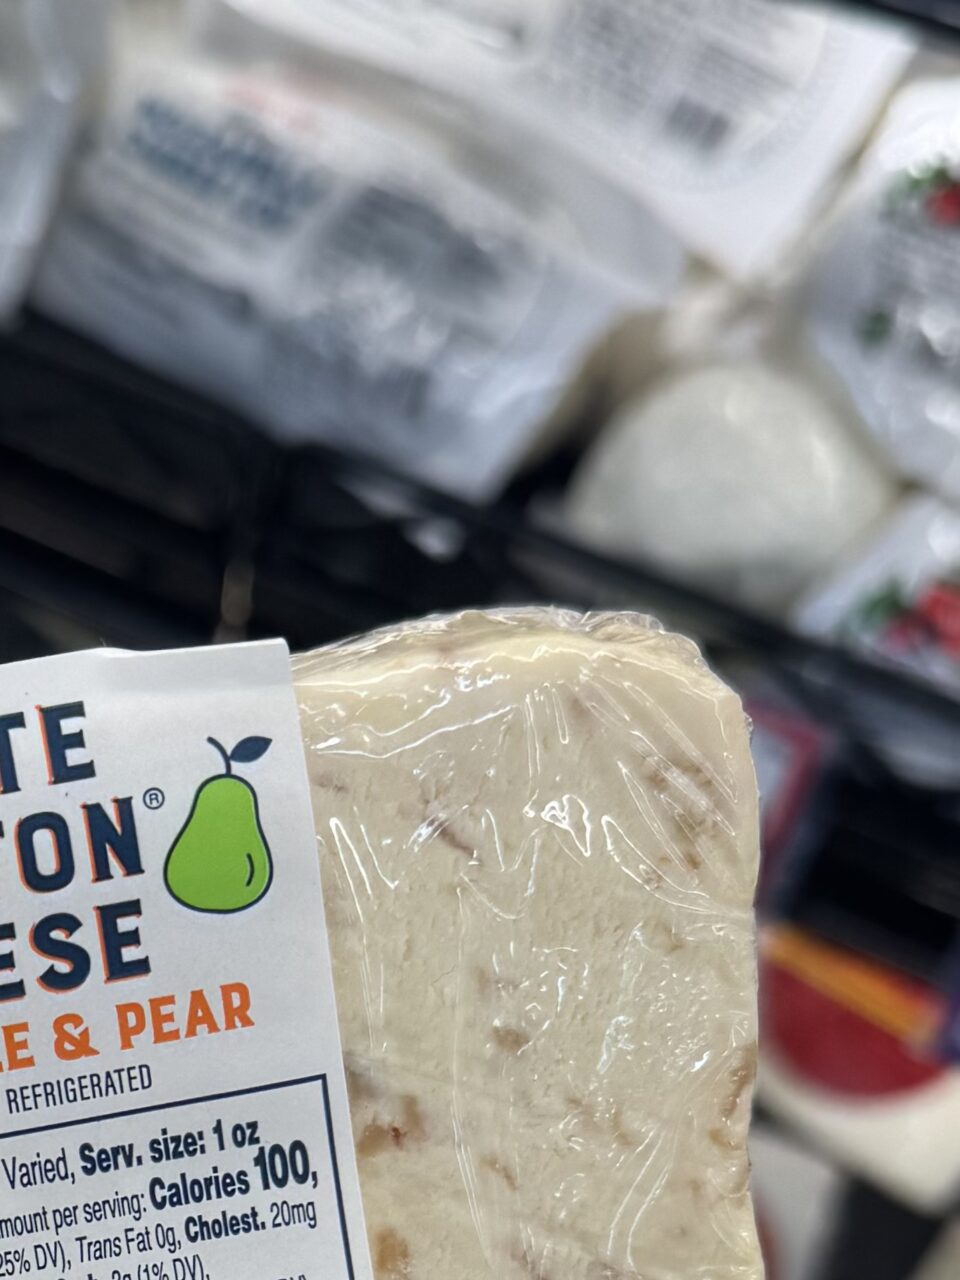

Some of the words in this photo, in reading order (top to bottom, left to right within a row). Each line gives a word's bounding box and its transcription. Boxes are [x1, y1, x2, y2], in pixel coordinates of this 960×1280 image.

[52, 1012, 100, 1061] &
[115, 981, 255, 1051] PEAR
[5, 1063, 153, 1115] REFRIGERATED
[0, 1147, 76, 1190] Varied,
[78, 1142, 144, 1177] Serv.
[148, 1127, 207, 1164] size:
[231, 1120, 261, 1149] oz
[51, 1204, 79, 1236] per
[82, 1190, 147, 1224] serving:
[148, 1165, 251, 1211] Calories
[252, 1139, 319, 1191] 100,
[33, 1240, 72, 1274] DV),
[74, 1235, 123, 1264] Trans
[123, 1226, 153, 1255] Fat
[184, 1206, 267, 1244] Cholest.
[269, 1200, 318, 1230] 20mg
